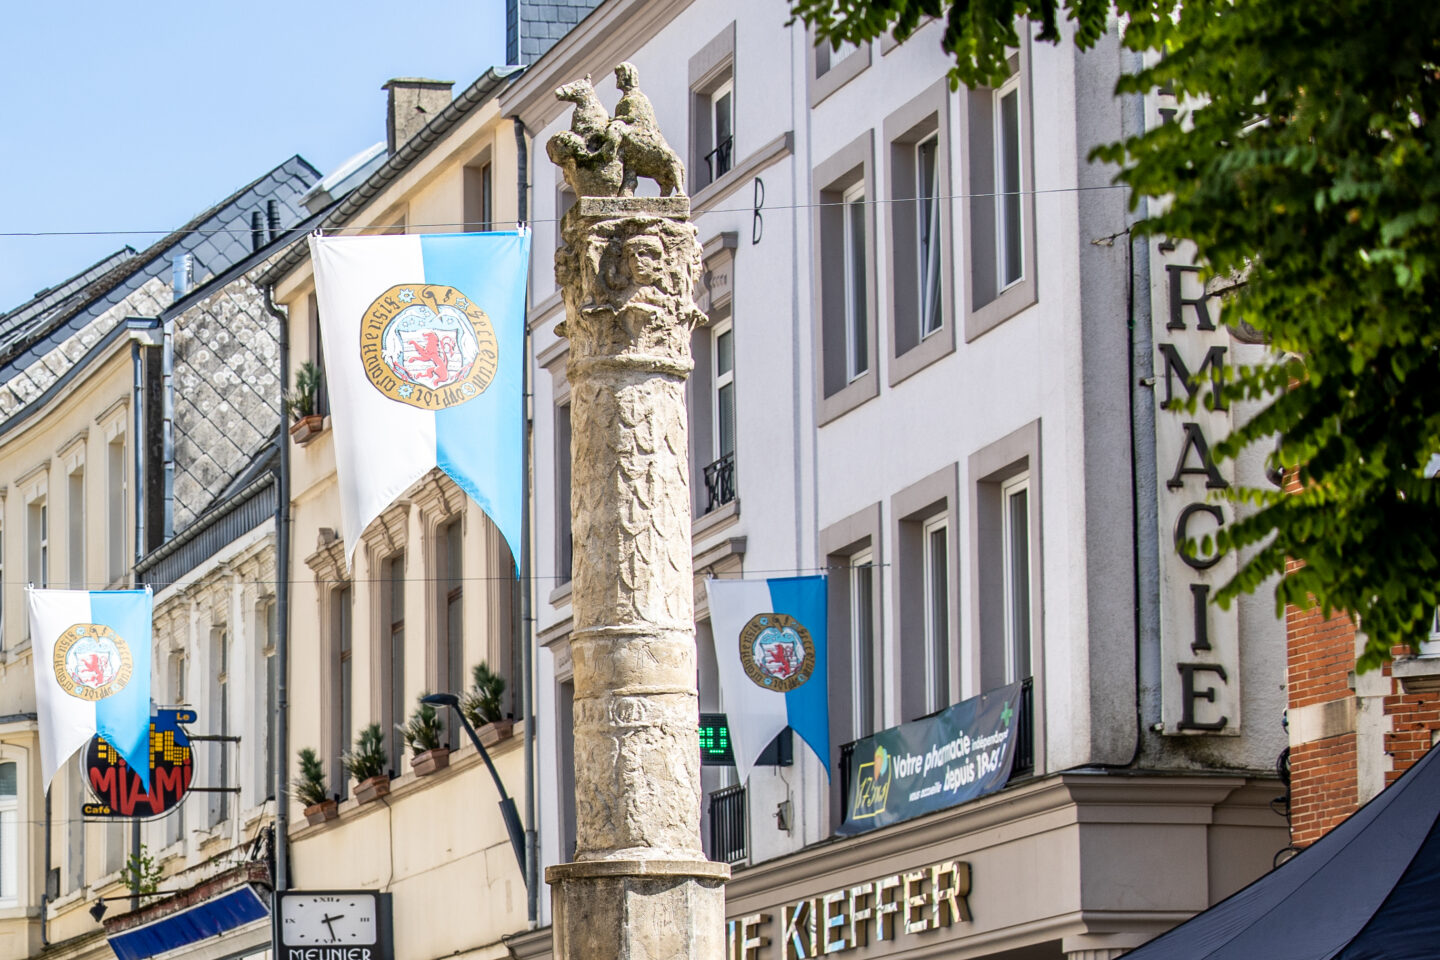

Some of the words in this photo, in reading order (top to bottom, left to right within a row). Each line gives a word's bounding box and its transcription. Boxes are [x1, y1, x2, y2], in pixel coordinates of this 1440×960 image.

[893, 751, 923, 780] Votre
[923, 730, 971, 778] pharmacie
[943, 759, 975, 794] depuis
[83, 805, 111, 815] Café
